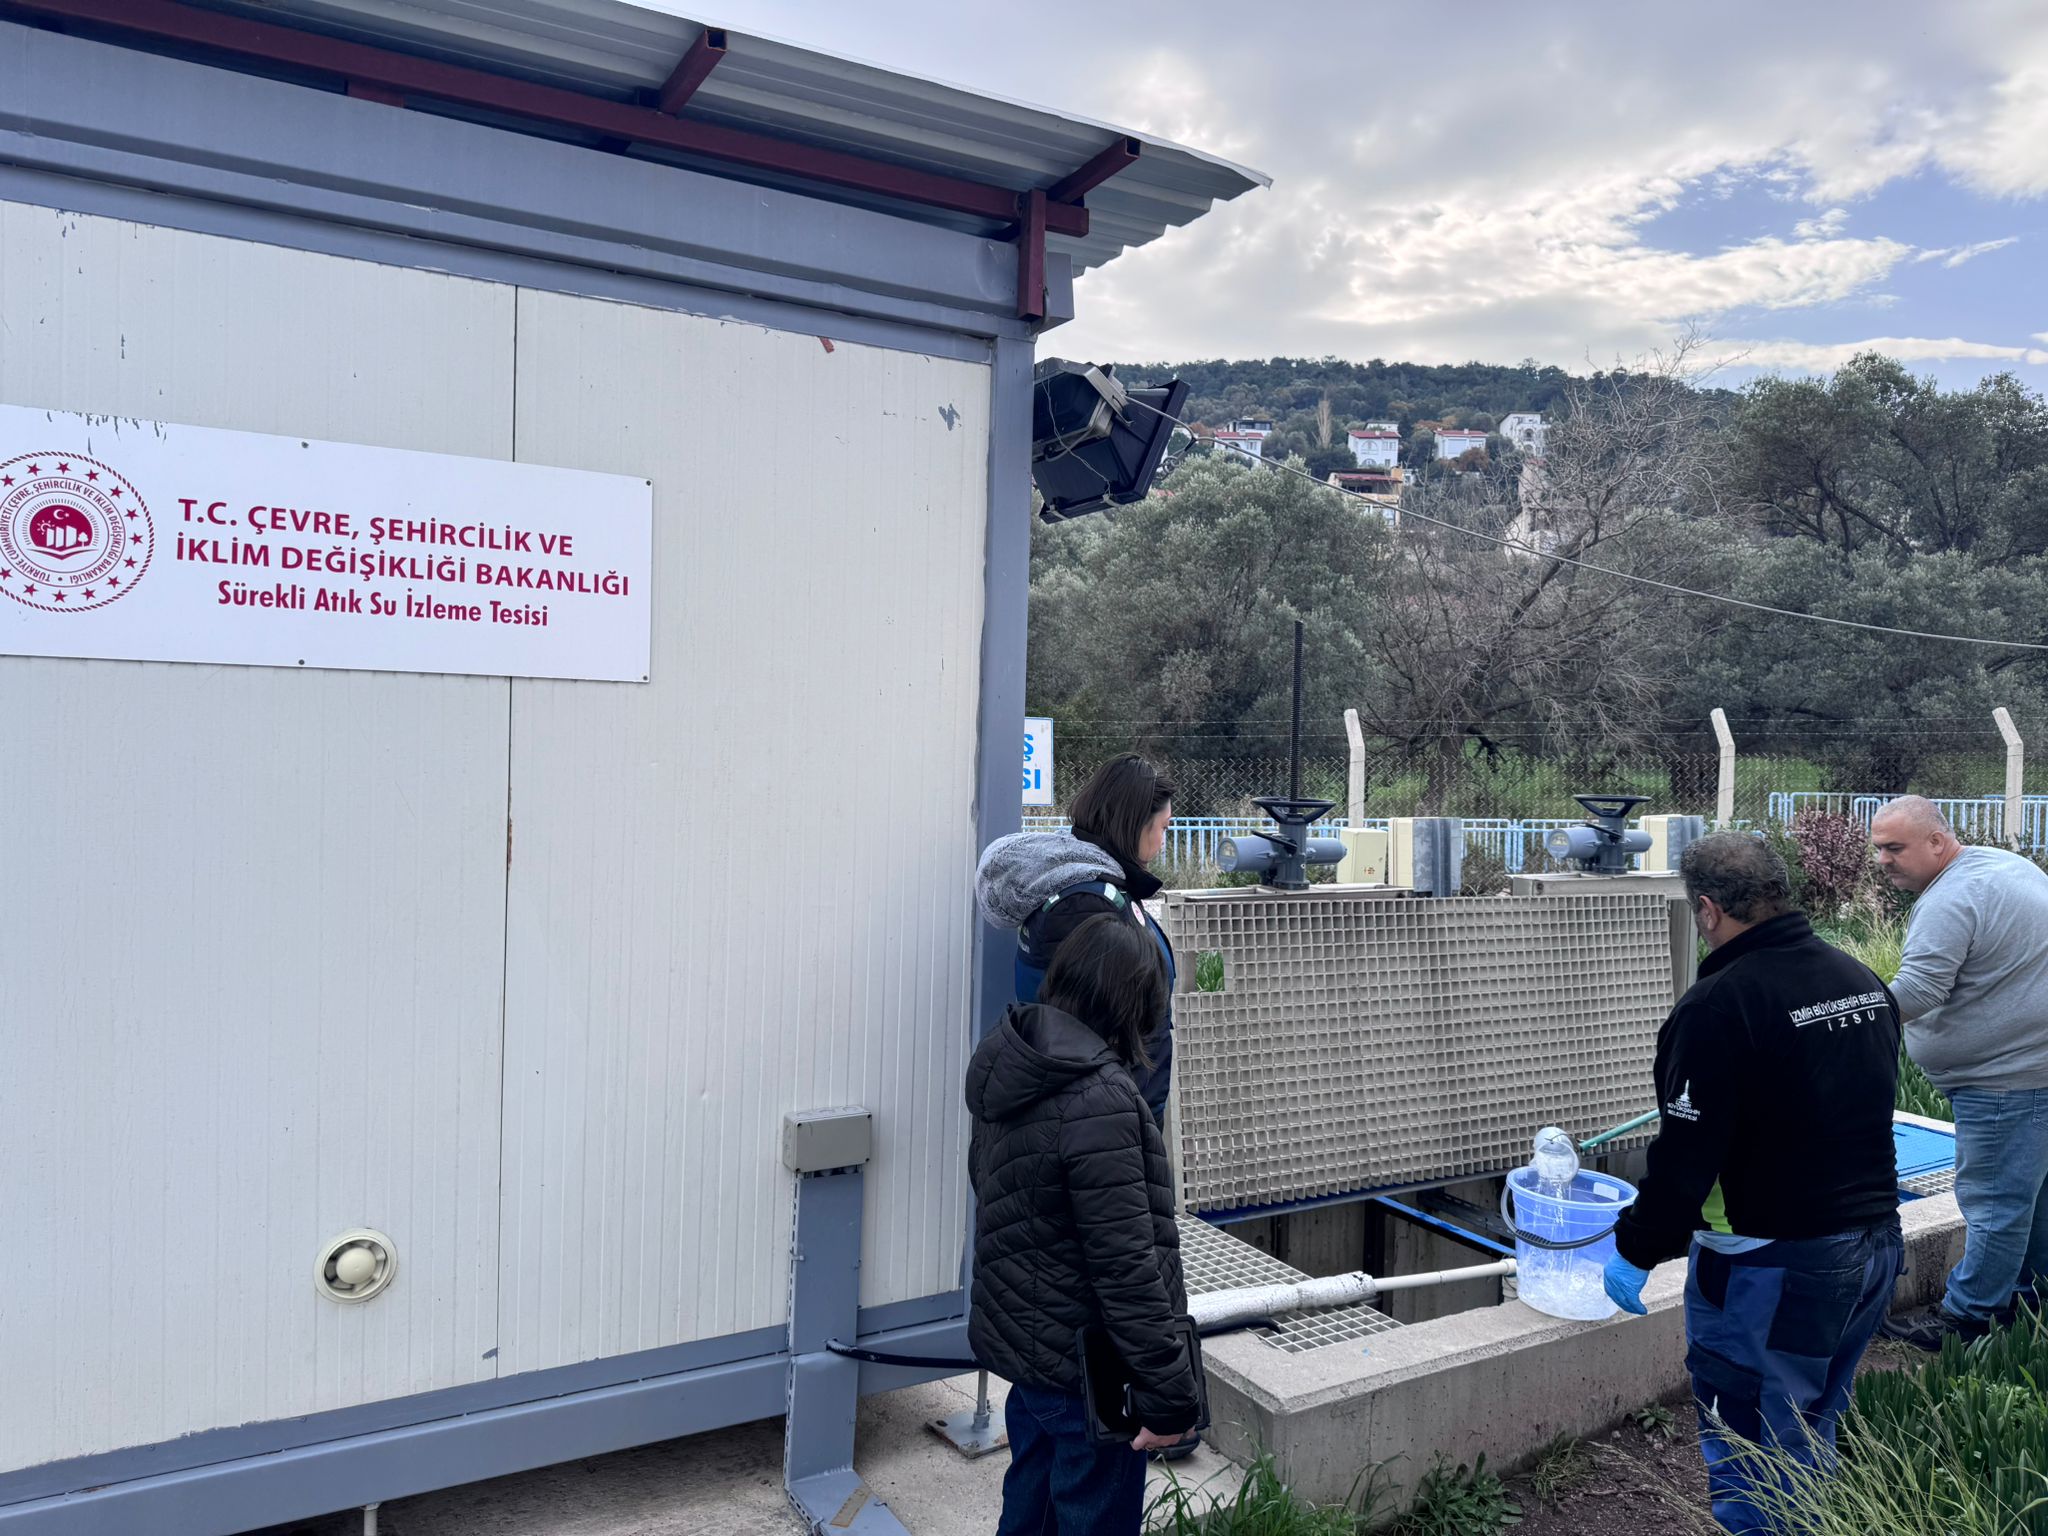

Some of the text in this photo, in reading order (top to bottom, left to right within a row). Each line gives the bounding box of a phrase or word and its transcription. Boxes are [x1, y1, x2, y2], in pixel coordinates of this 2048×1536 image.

[9, 487, 34, 508] ÇEVRE,
[32, 480, 82, 493] ŞEHİRCİLİK
[83, 486, 95, 498] VE
[93, 493, 115, 517] İKLİM
[178, 498, 573, 557] T.C. ÇEVRE, ŞEHİRCİLİK VE
[16, 559, 51, 582] TÜRKİYE
[69, 558, 113, 584] BAKANLIĞI
[176, 531, 629, 597] İKLİM DEĞİŞİKLİĞİ BAKANLIĞI
[218, 580, 548, 626] Sürekli Atık Su İzleme Tesisi
[1788, 1006, 1814, 1023] İZMİR
